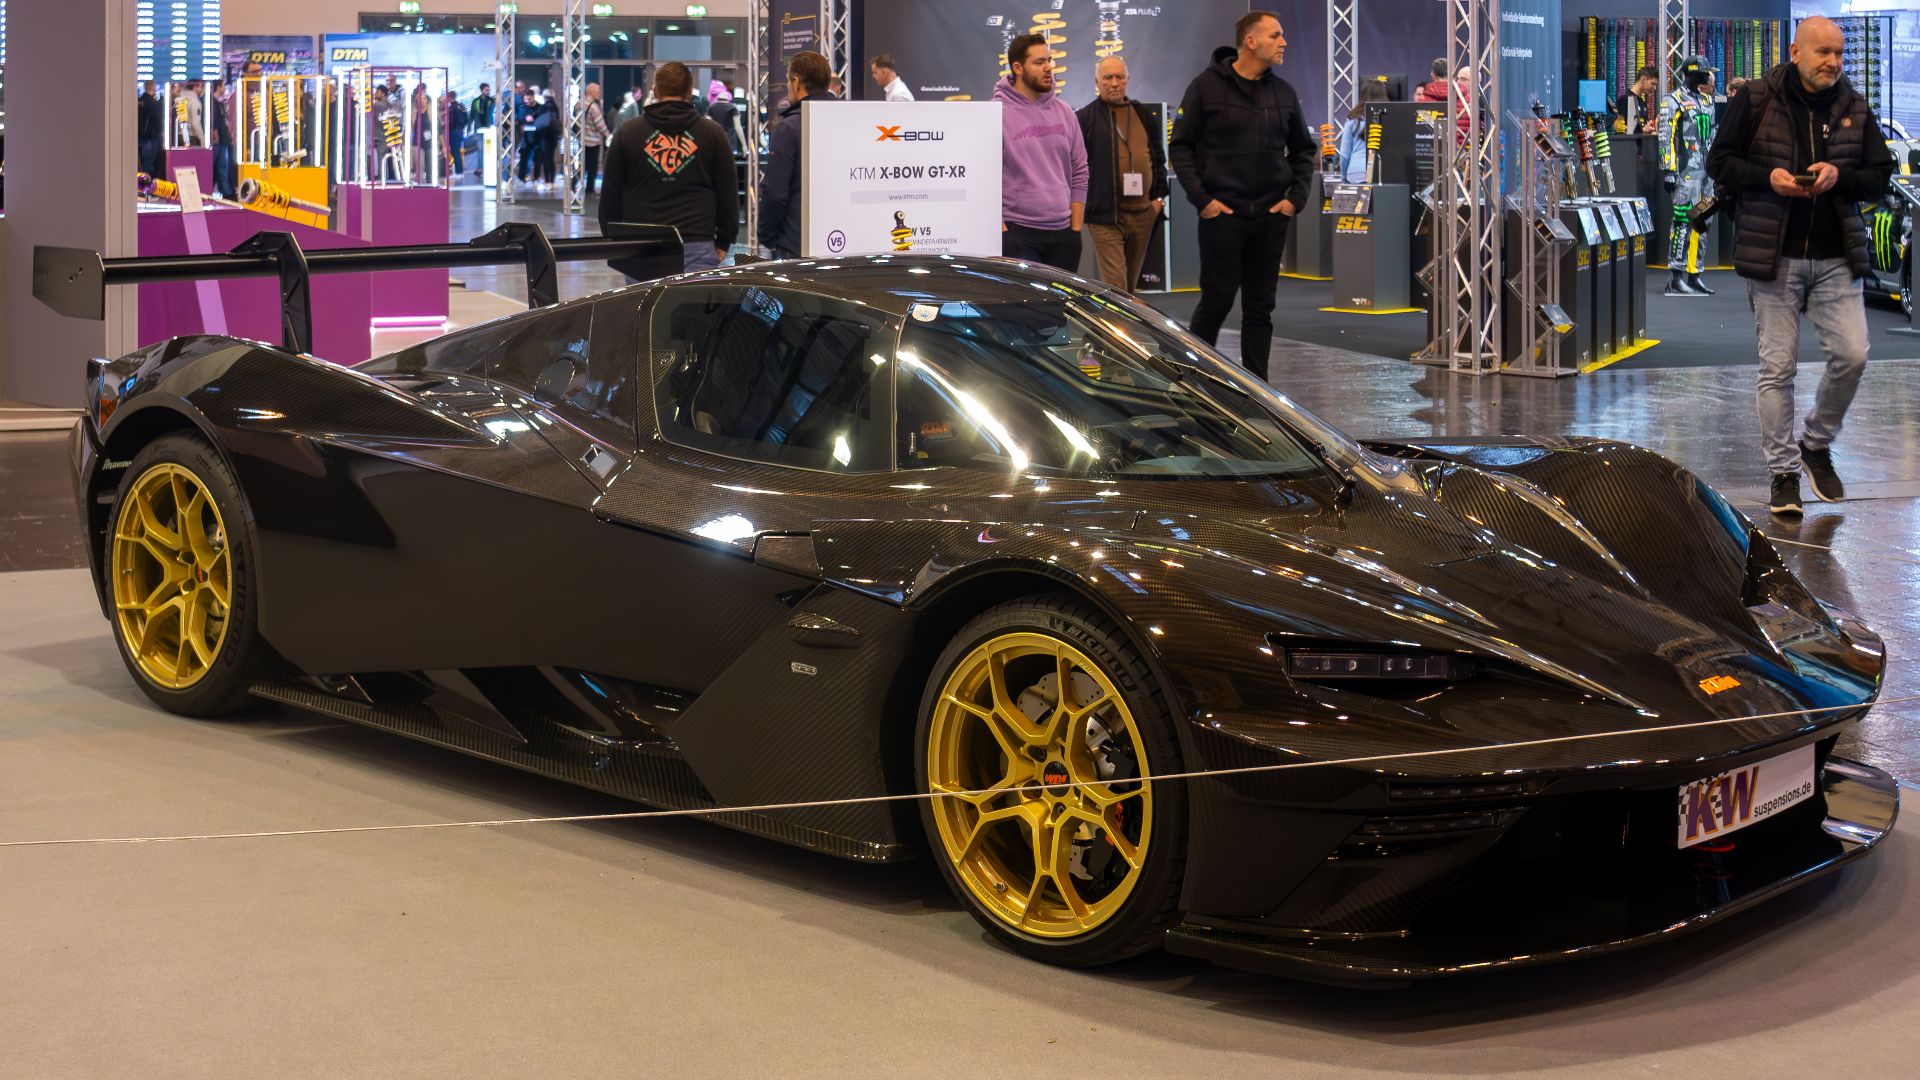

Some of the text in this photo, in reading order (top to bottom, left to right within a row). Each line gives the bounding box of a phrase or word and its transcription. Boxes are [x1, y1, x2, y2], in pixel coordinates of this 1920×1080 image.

[251, 52, 285, 63] DTM
[332, 49, 367, 61] DTM
[850, 165, 966, 180] KTM X-BOW GT-XR
[920, 227, 931, 236] V5
[830, 237, 843, 247] V5
[1685, 765, 1760, 842] KW
[1754, 781, 1812, 818] suspensions.de
